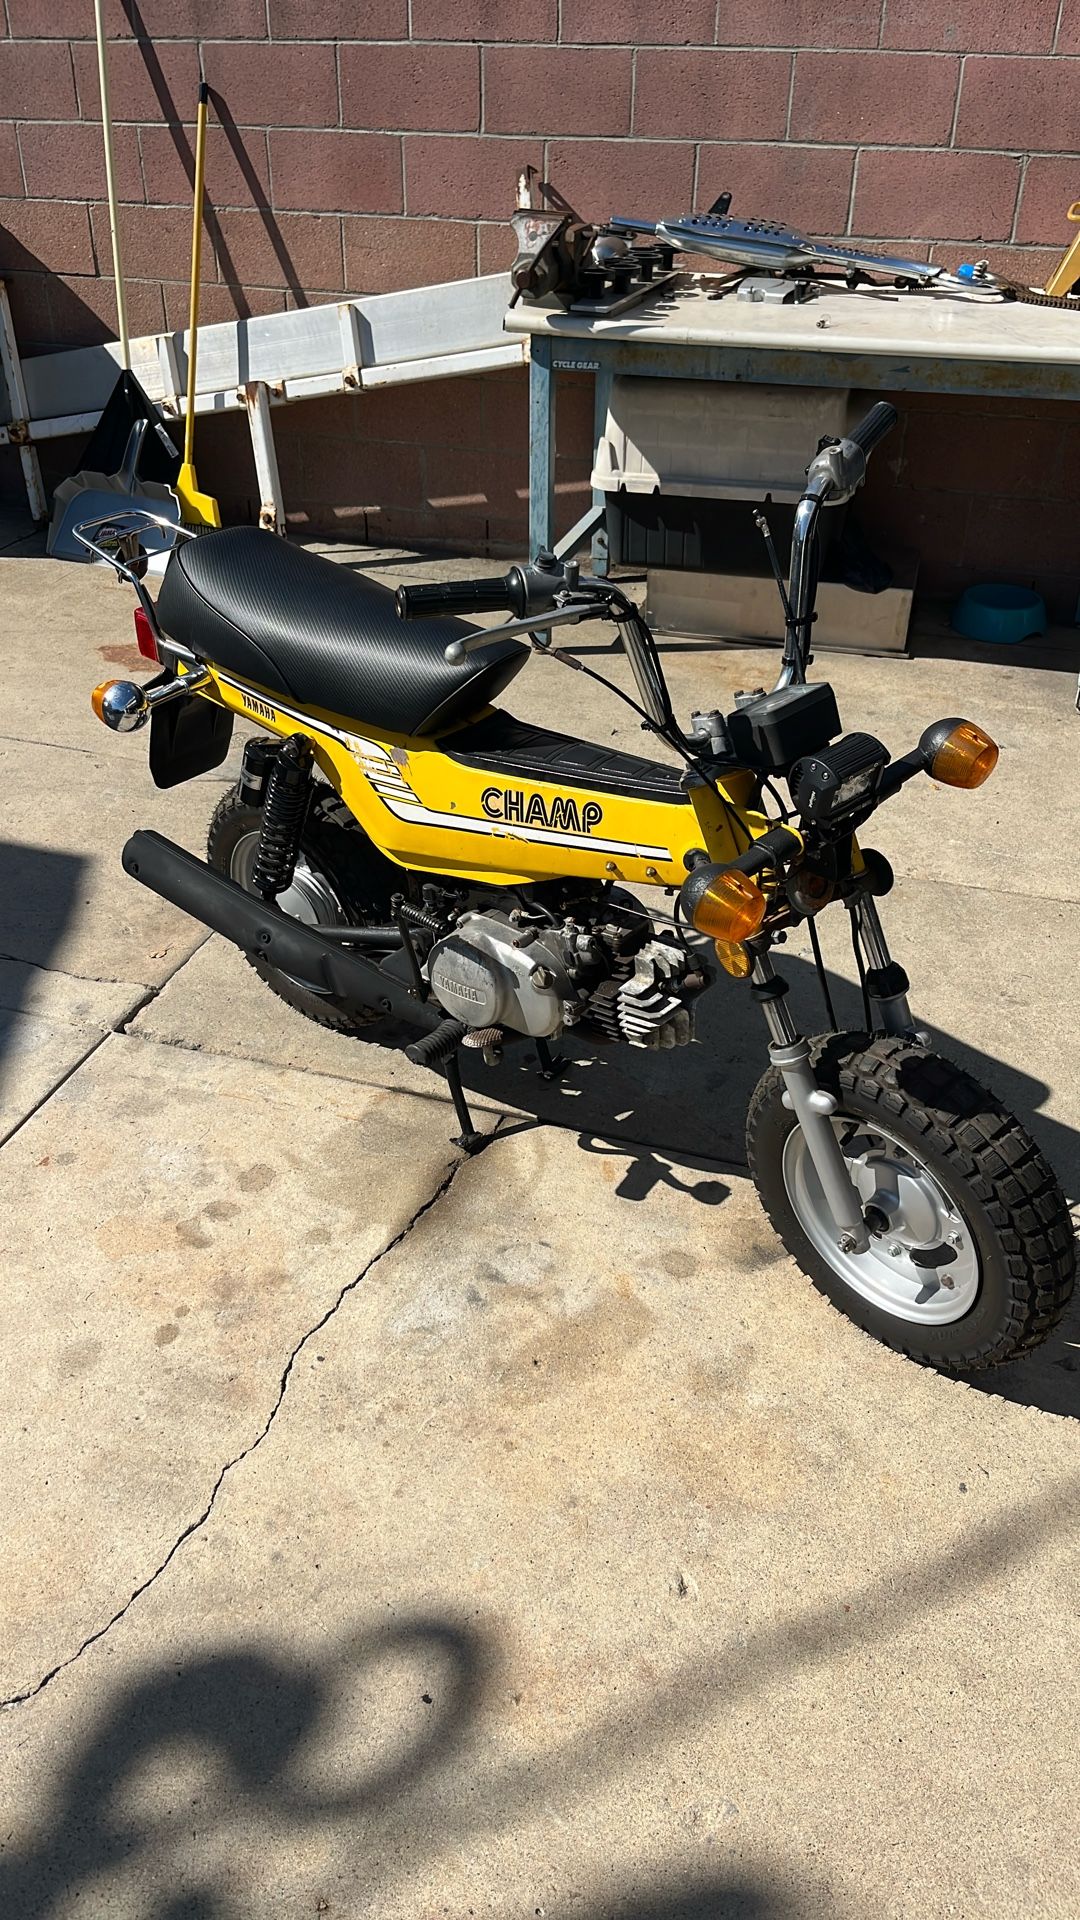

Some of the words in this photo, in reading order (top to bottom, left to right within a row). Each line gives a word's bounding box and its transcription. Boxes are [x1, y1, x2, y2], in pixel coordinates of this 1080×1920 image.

[552, 360, 576, 369] CYCLE
[576, 361, 600, 369] GEAR
[241, 693, 276, 722] YAMAHA
[481, 787, 603, 834] CHAMP
[439, 974, 479, 1002] YAMAHA
